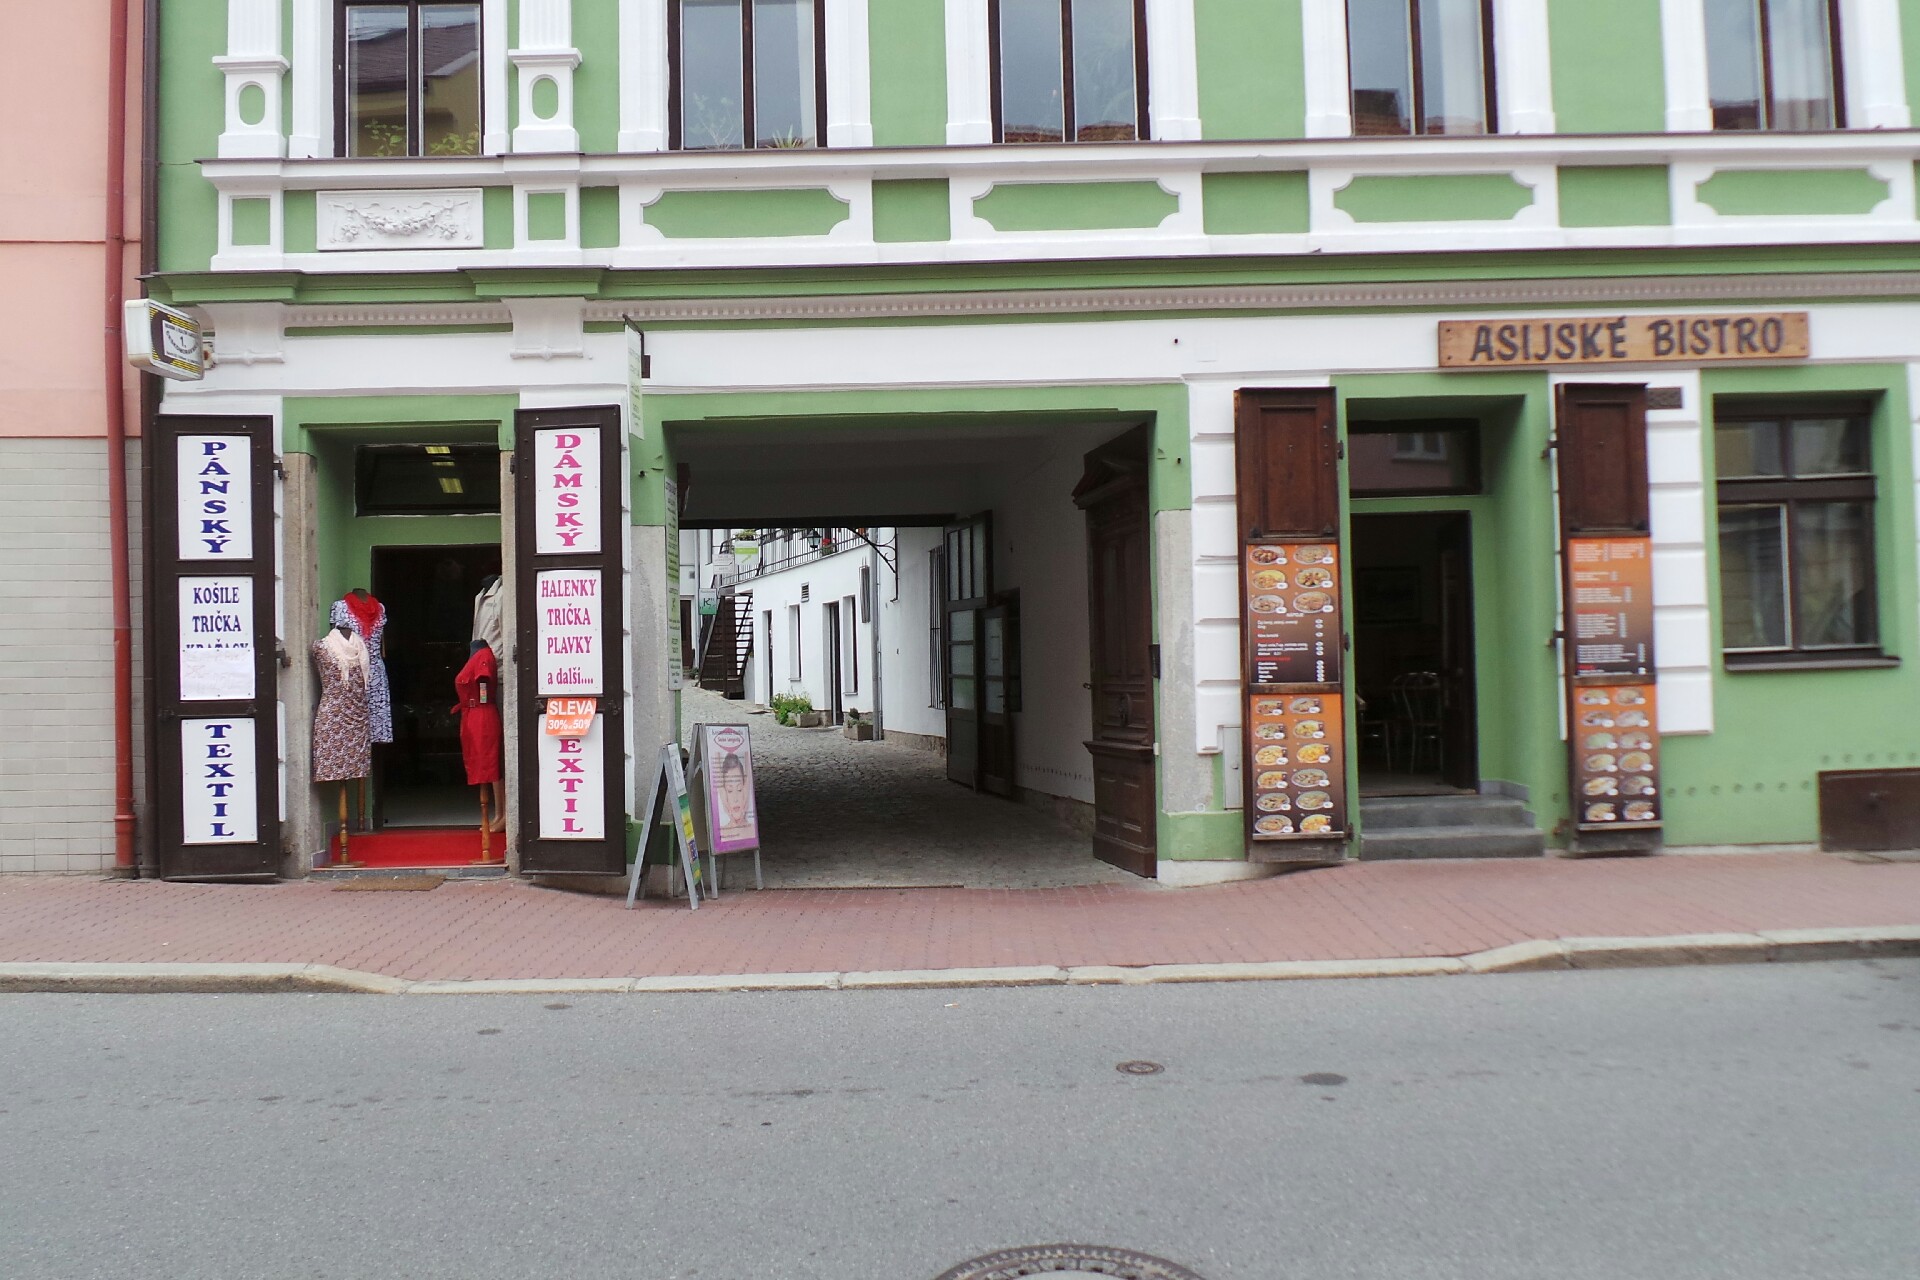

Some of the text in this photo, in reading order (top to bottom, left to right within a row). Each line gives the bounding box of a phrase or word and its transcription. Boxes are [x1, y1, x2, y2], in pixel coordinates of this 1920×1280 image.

[1470, 316, 1785, 361] ASIJSKÉ BISTRO
[198, 441, 232, 554] PÁNSKÝ
[553, 434, 584, 547] DÁMSKÝ
[193, 582, 240, 604] KOŠILE
[541, 579, 597, 598] HALENKY
[192, 610, 242, 633] TRIČKA
[546, 603, 592, 626] TRIČKA
[547, 635, 593, 655] PLAVKY
[547, 672, 554, 685] a
[549, 700, 595, 716] SLEVA
[547, 719, 568, 730] 30%
[204, 724, 235, 837] TEXTIL
[556, 737, 585, 833] EXTIL
